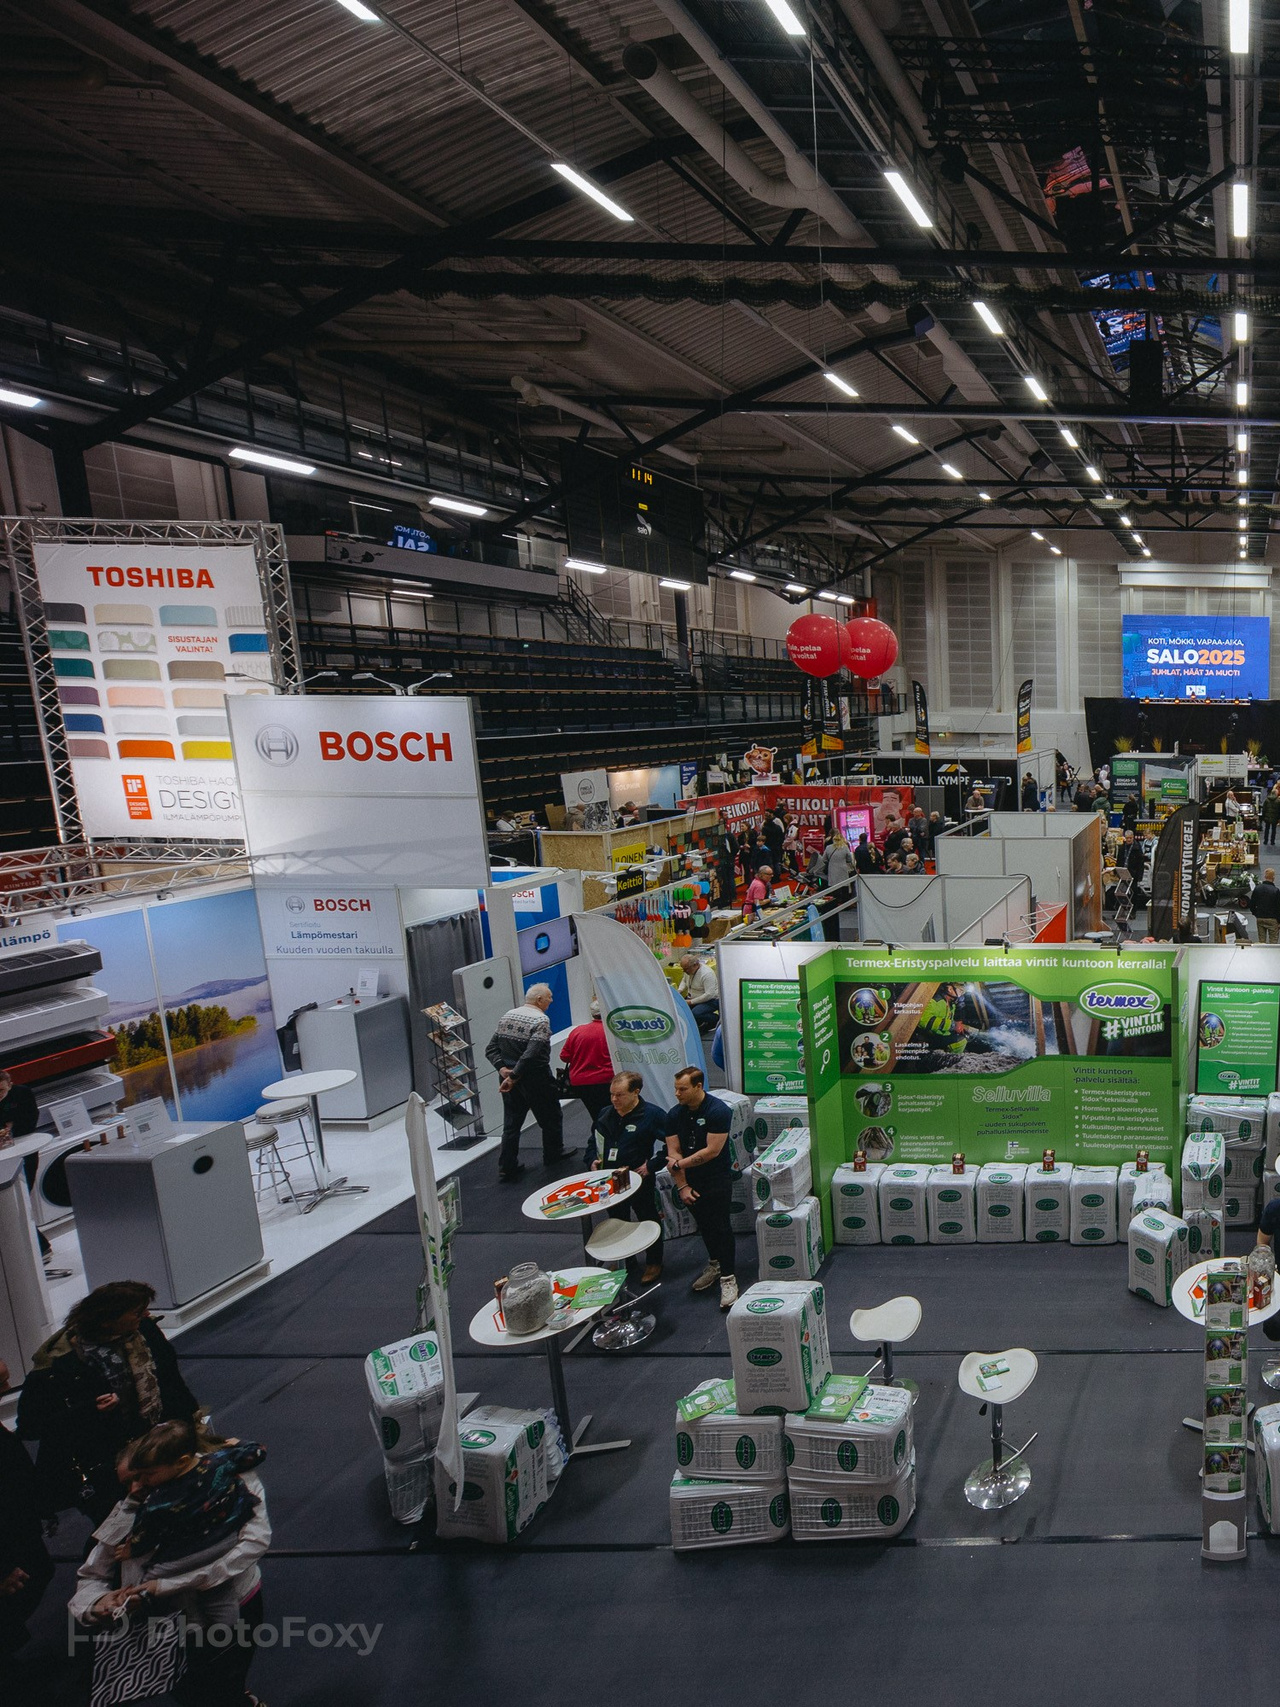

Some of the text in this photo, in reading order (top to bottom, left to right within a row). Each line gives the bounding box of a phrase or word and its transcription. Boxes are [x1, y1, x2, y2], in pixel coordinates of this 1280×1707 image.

[86, 566, 215, 589] TOSHIBA
[167, 635, 218, 643] SISUSTAJAN
[1168, 637, 1195, 646] MÖKKI,
[1196, 638, 1244, 646] VAPAA-AIKA,
[175, 645, 213, 653] VALINTA!
[800, 645, 822, 653] pelaa
[1147, 648, 1245, 665] SALO2025
[1152, 668, 1182, 677] JUHLAT,
[1183, 668, 1204, 676] HÄÄT
[318, 730, 453, 762] BOSCH
[156, 775, 206, 786] TOSHIBA
[159, 790, 241, 810] DESIGN
[4, 880, 41, 890] KIINTEIST
[617, 874, 643, 892] Keittiö
[313, 898, 372, 912] BOSCH
[291, 931, 358, 940] Lämpömestari
[276, 945, 394, 955] Kuuden vuoden takuulla
[846, 956, 1167, 971] Termex-Eristyspalvelu laittaa vintit kuntoon kerralla!
[881, 990, 887, 999] 1
[747, 1001, 755, 1010] 1.
[1087, 991, 1154, 1011] termex
[893, 1002, 924, 1010] Yläpohjan
[747, 1020, 756, 1030] 2.
[1123, 1023, 1164, 1038] KUNTOON
[883, 1033, 890, 1042] 2
[747, 1040, 757, 1049] 3.
[747, 1059, 757, 1068] 4.
[1073, 1066, 1133, 1075] Vintit kuntoon
[1073, 1076, 1140, 1085] -palvelu sisältää:
[885, 1083, 892, 1092] 3
[972, 1086, 1052, 1103] Selluvilla
[1081, 1089, 1151, 1097] Termex-lisäeristyksen
[1112, 1106, 1158, 1114] paloeristykset
[1081, 1115, 1159, 1124] IV-putkien lisäeristykset
[1008, 1121, 1046, 1129] sukupolven
[1081, 1124, 1125, 1132] Kulkusiltojen
[887, 1127, 894, 1136] 4
[976, 1128, 1050, 1136] puhalluslämmöneriste
[1082, 1132, 1169, 1142] Tuuletuksen parantamisen
[1082, 1142, 1133, 1151] Tuulenohjaimet
